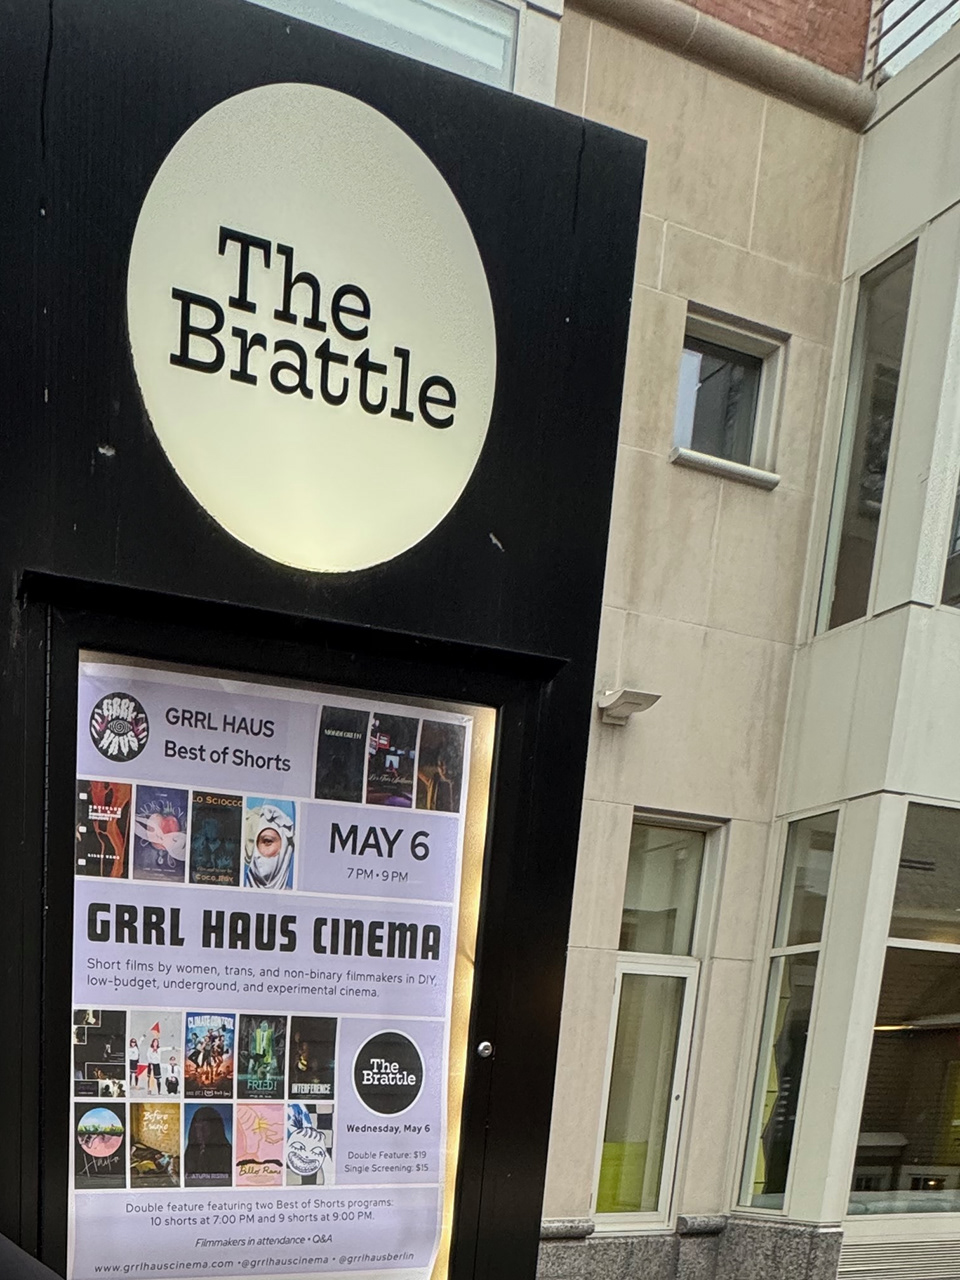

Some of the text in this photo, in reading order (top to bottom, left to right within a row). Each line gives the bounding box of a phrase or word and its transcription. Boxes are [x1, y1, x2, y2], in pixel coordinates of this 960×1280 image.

[218, 226, 371, 341] The
[170, 287, 457, 429] Brattle
[102, 697, 136, 721] GRRL
[165, 707, 275, 738] GRRL HAUS
[98, 729, 138, 757] HAUS
[164, 740, 291, 772] Best of Shorts
[330, 822, 430, 861] MAY 6
[87, 902, 441, 961] GRRL HAUS CINEMA
[87, 958, 121, 971] Short
[125, 959, 153, 972] films
[158, 961, 172, 975] by
[176, 964, 220, 976] women,
[224, 965, 255, 978] trans,
[259, 967, 280, 978] and
[284, 968, 343, 982] non-binary
[346, 970, 403, 984] filmmakers
[406, 973, 415, 984] in
[87, 974, 380, 998] low-budget, underground, and experimental cinema.
[370, 1059, 399, 1073] The
[362, 1071, 417, 1086] Brattle
[346, 1124, 431, 1135] Wednesday, May 6
[348, 1150, 427, 1160] Double Feature: $19
[344, 1163, 429, 1174] Single Screening: $15
[126, 1203, 164, 1213] Double
[167, 1202, 204, 1212] feature
[207, 1201, 253, 1213] featuring
[256, 1201, 274, 1210] two
[276, 1200, 298, 1210] Best
[301, 1199, 311, 1209] of
[314, 1199, 345, 1209] Shorts
[150, 1211, 375, 1226] 10 shorts at 7:00 PM and 9 shorts at 9:00 PM.
[195, 1234, 333, 1248] Filmmakers in attendance Q&A
[94, 1252, 414, 1274] www.grrlhauscinema.com @grrlhauscinema @grrlhausberlin
